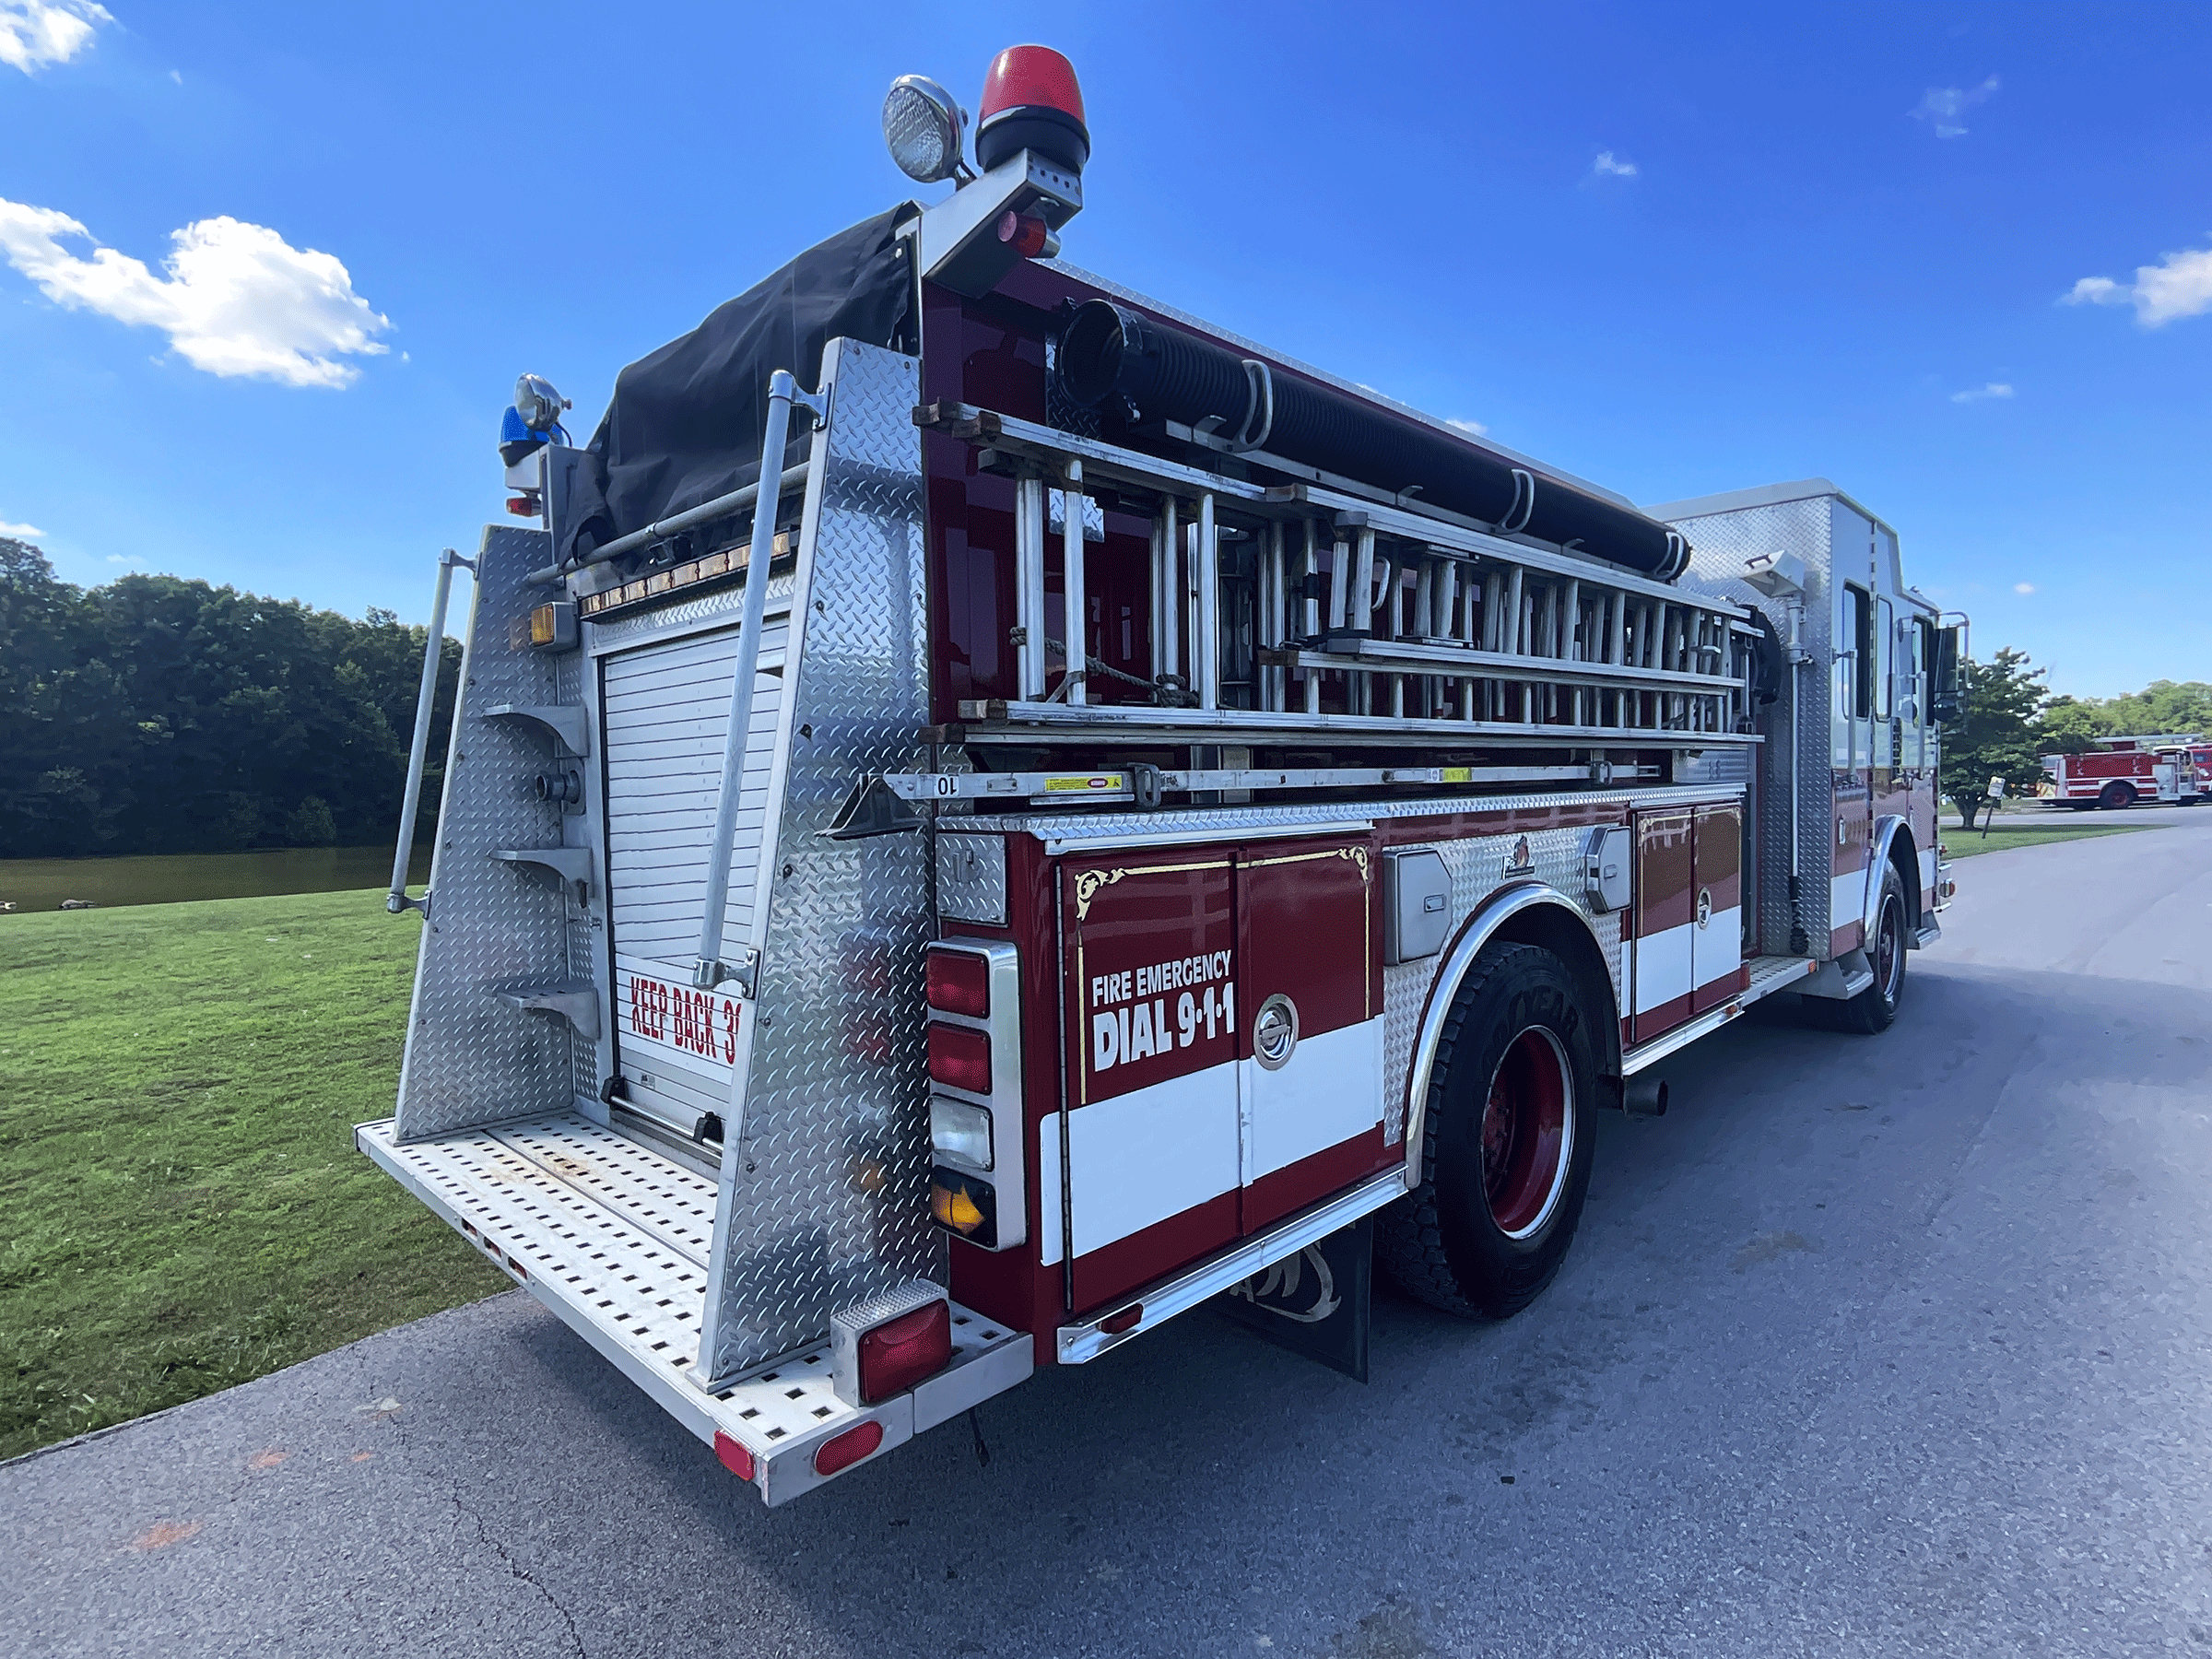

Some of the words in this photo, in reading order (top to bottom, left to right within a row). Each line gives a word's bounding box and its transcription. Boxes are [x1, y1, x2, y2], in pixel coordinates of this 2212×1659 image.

[1092, 971, 1133, 1007] FIRE
[1136, 949, 1231, 997] EMERGENCY
[630, 976, 668, 1041] KEEP
[673, 987, 717, 1059] BACK
[1092, 998, 1172, 1072] DIAL
